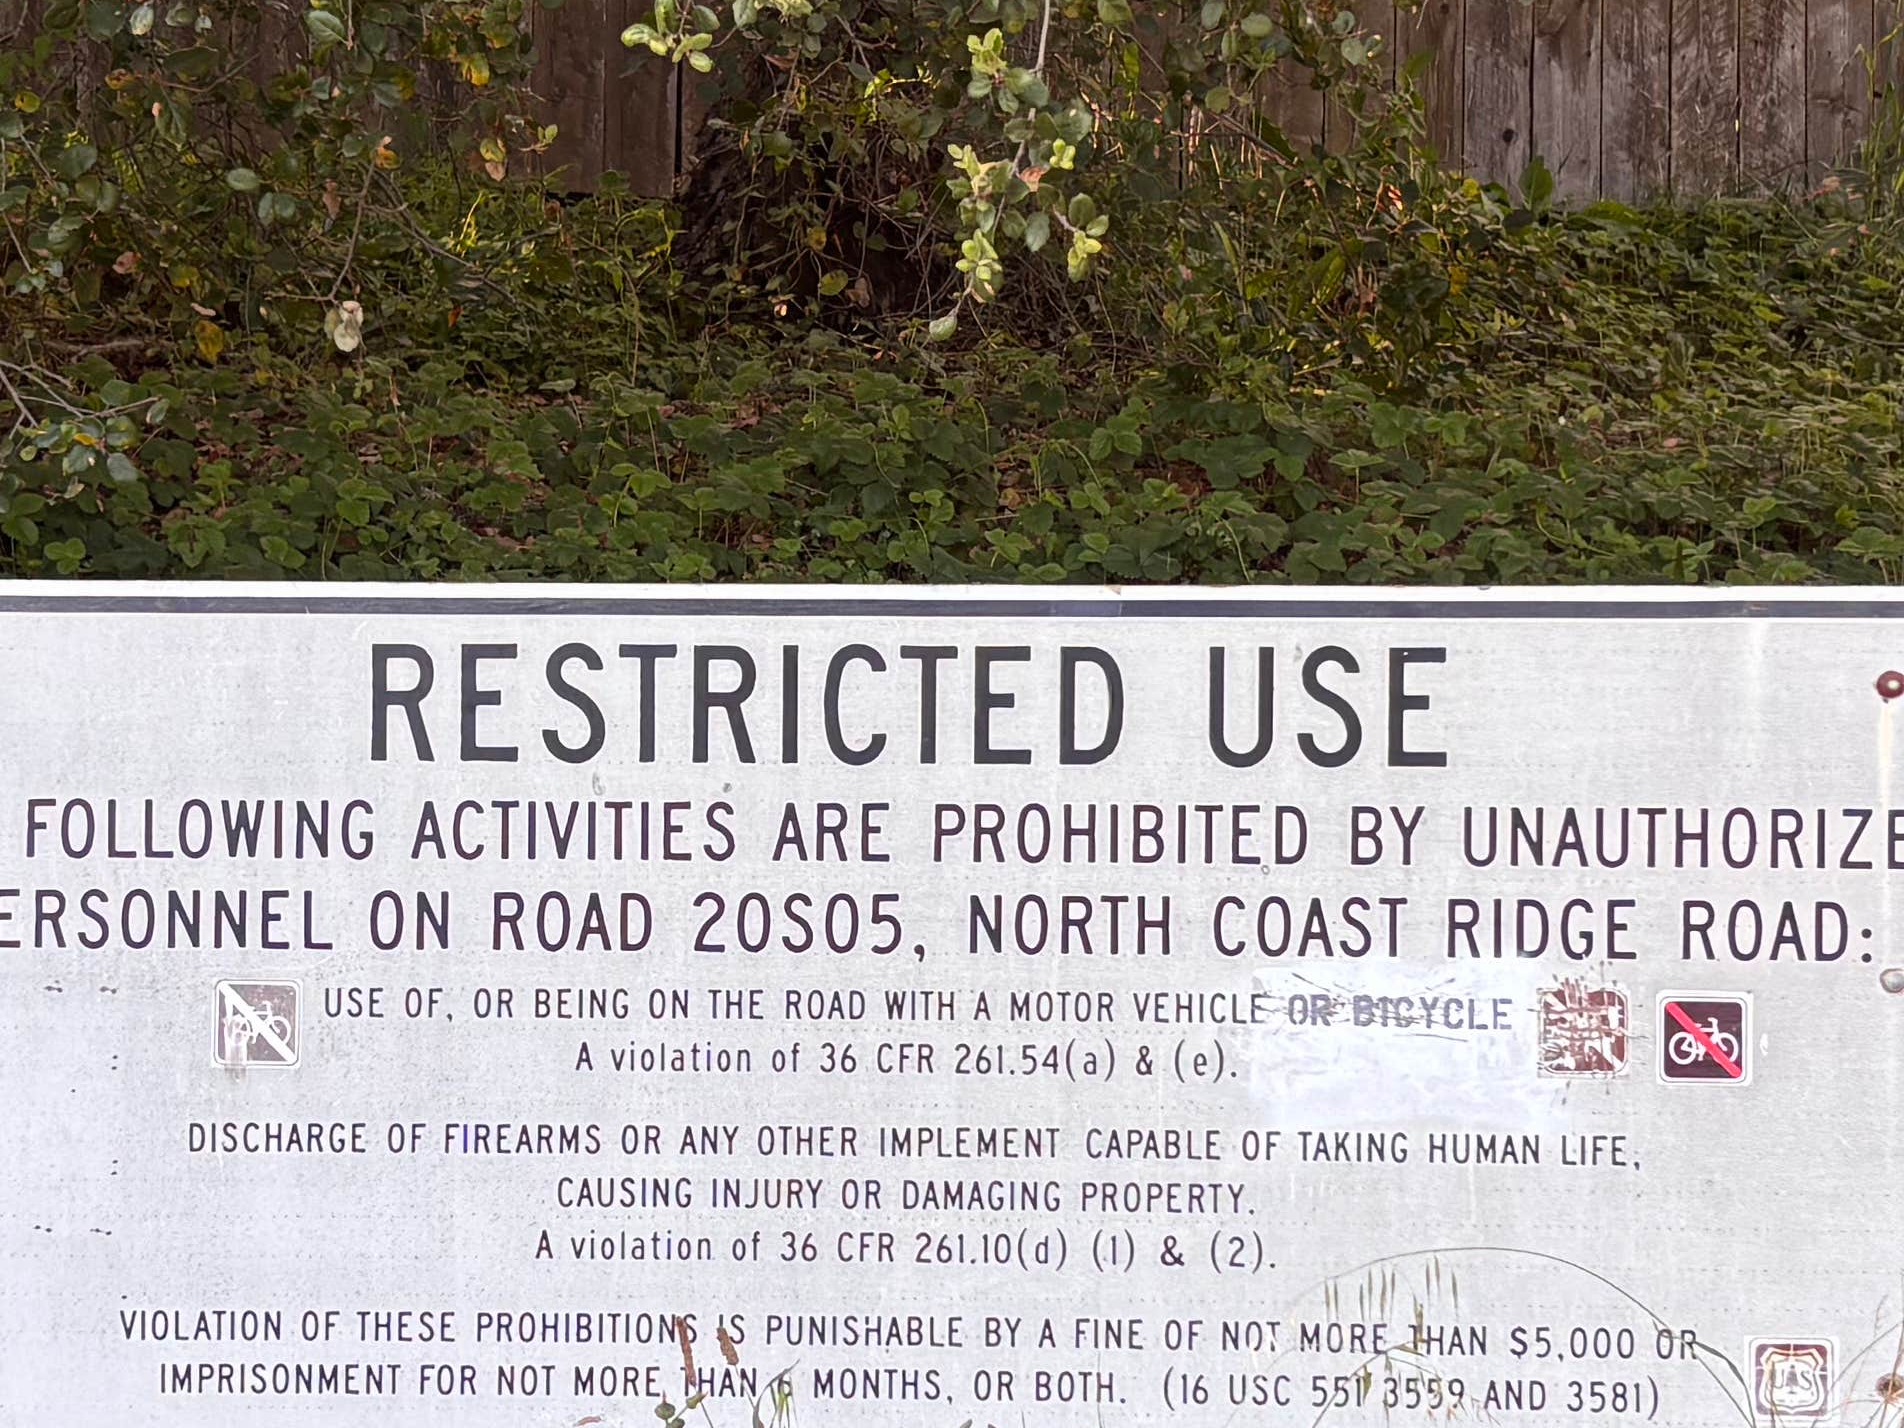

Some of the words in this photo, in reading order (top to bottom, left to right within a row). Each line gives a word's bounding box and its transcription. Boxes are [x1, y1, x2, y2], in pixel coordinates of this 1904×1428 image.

[370, 642, 1125, 767] RESTRICTED
[1208, 645, 1448, 769] USE
[26, 797, 374, 861] FOLLOWING
[410, 799, 736, 862] ACTIVITIES
[771, 802, 891, 863] ARE
[933, 802, 1308, 866] PROHIBITED
[1350, 805, 1426, 866] BY
[369, 889, 450, 951] ON
[492, 890, 653, 953] ROAD
[692, 891, 925, 963] 20S05,
[969, 893, 1171, 956] NORTH
[1213, 895, 1409, 958] COAST
[1447, 898, 1637, 961] RIDGE
[1681, 899, 1873, 964] ROAD:
[324, 987, 385, 1018] USE
[404, 987, 453, 1023] OF,
[473, 987, 514, 1019] OR
[534, 987, 629, 1020] BEING
[648, 988, 689, 1020] ON
[707, 989, 764, 1020] THE
[785, 989, 866, 1021] ROAD
[884, 990, 955, 1021] WITH
[973, 990, 992, 1021] A
[1010, 990, 1114, 1023] MOTOR
[1132, 991, 1266, 1025] VEHICLE
[1287, 992, 1332, 1027] OR
[1352, 993, 1514, 1031] BICYCLE
[575, 1041, 594, 1072] A
[610, 1042, 751, 1073] violation
[771, 1042, 801, 1073] of
[819, 1042, 857, 1074] 36
[876, 1042, 934, 1074] CFR
[954, 1037, 1116, 1083] 261.54(a)
[1135, 1044, 1155, 1076] &
[1172, 1039, 1238, 1084] (e).
[188, 1122, 367, 1154] DISCHARGE
[387, 1122, 427, 1154] OF
[444, 1122, 601, 1155] FIREARMS
[621, 1124, 661, 1155] OR
[679, 1125, 740, 1156] ANY
[757, 1125, 857, 1157] OTHER
[880, 1126, 1061, 1159] IMPLEMENT
[1086, 1127, 1221, 1161] CAPABLE
[1241, 1130, 1281, 1162] OF
[1297, 1131, 1408, 1164] TAKING
[1428, 1133, 1540, 1165] HUMAN
[1560, 1134, 1642, 1171] LIFE,
[557, 1176, 692, 1209] CAUSING
[712, 1177, 824, 1209] INJURY
[841, 1178, 882, 1210] OR
[902, 1179, 1061, 1212] DAMAGING
[1081, 1181, 1255, 1216] PROPERTY.
[535, 1229, 554, 1260] A
[570, 1230, 712, 1261] violation
[731, 1230, 761, 1262] of
[780, 1230, 818, 1262] 36
[837, 1231, 895, 1263] CFR
[914, 1227, 1068, 1273] 261.10(d)
[1092, 1227, 1136, 1274] (1)
[1159, 1235, 1186, 1267] &
[1209, 1228, 1277, 1275] (2).
[119, 1309, 282, 1342] VIOLATION
[301, 1310, 341, 1342] OF
[356, 1311, 456, 1343] THESE
[476, 1311, 699, 1345] PROHIBITIONS
[766, 1314, 963, 1348] PUNISHABLE
[984, 1316, 1022, 1348] BY
[1038, 1318, 1057, 1349] A
[1075, 1317, 1144, 1351] FINE
[1164, 1319, 1204, 1351] OF
[1222, 1320, 1281, 1353] NOT
[1298, 1322, 1389, 1355] MORE
[1407, 1323, 1488, 1357] THAN
[1509, 1325, 1635, 1363] $5,000
[1655, 1327, 1699, 1361] OR
[160, 1362, 402, 1395] IMPRISONMENT
[419, 1363, 477, 1396] FOR
[497, 1364, 556, 1397] NOT
[574, 1365, 661, 1398] MORE
[680, 1366, 758, 1398] THAN
[813, 1367, 953, 1405] MONTHS,
[973, 1369, 1014, 1402] OR
[1035, 1370, 1126, 1404] BOTH.
[1163, 1365, 1210, 1412] (16
[1229, 1374, 1291, 1407] USC
[1483, 1379, 1546, 1411] AND
[1566, 1375, 1659, 1421] 3581)
